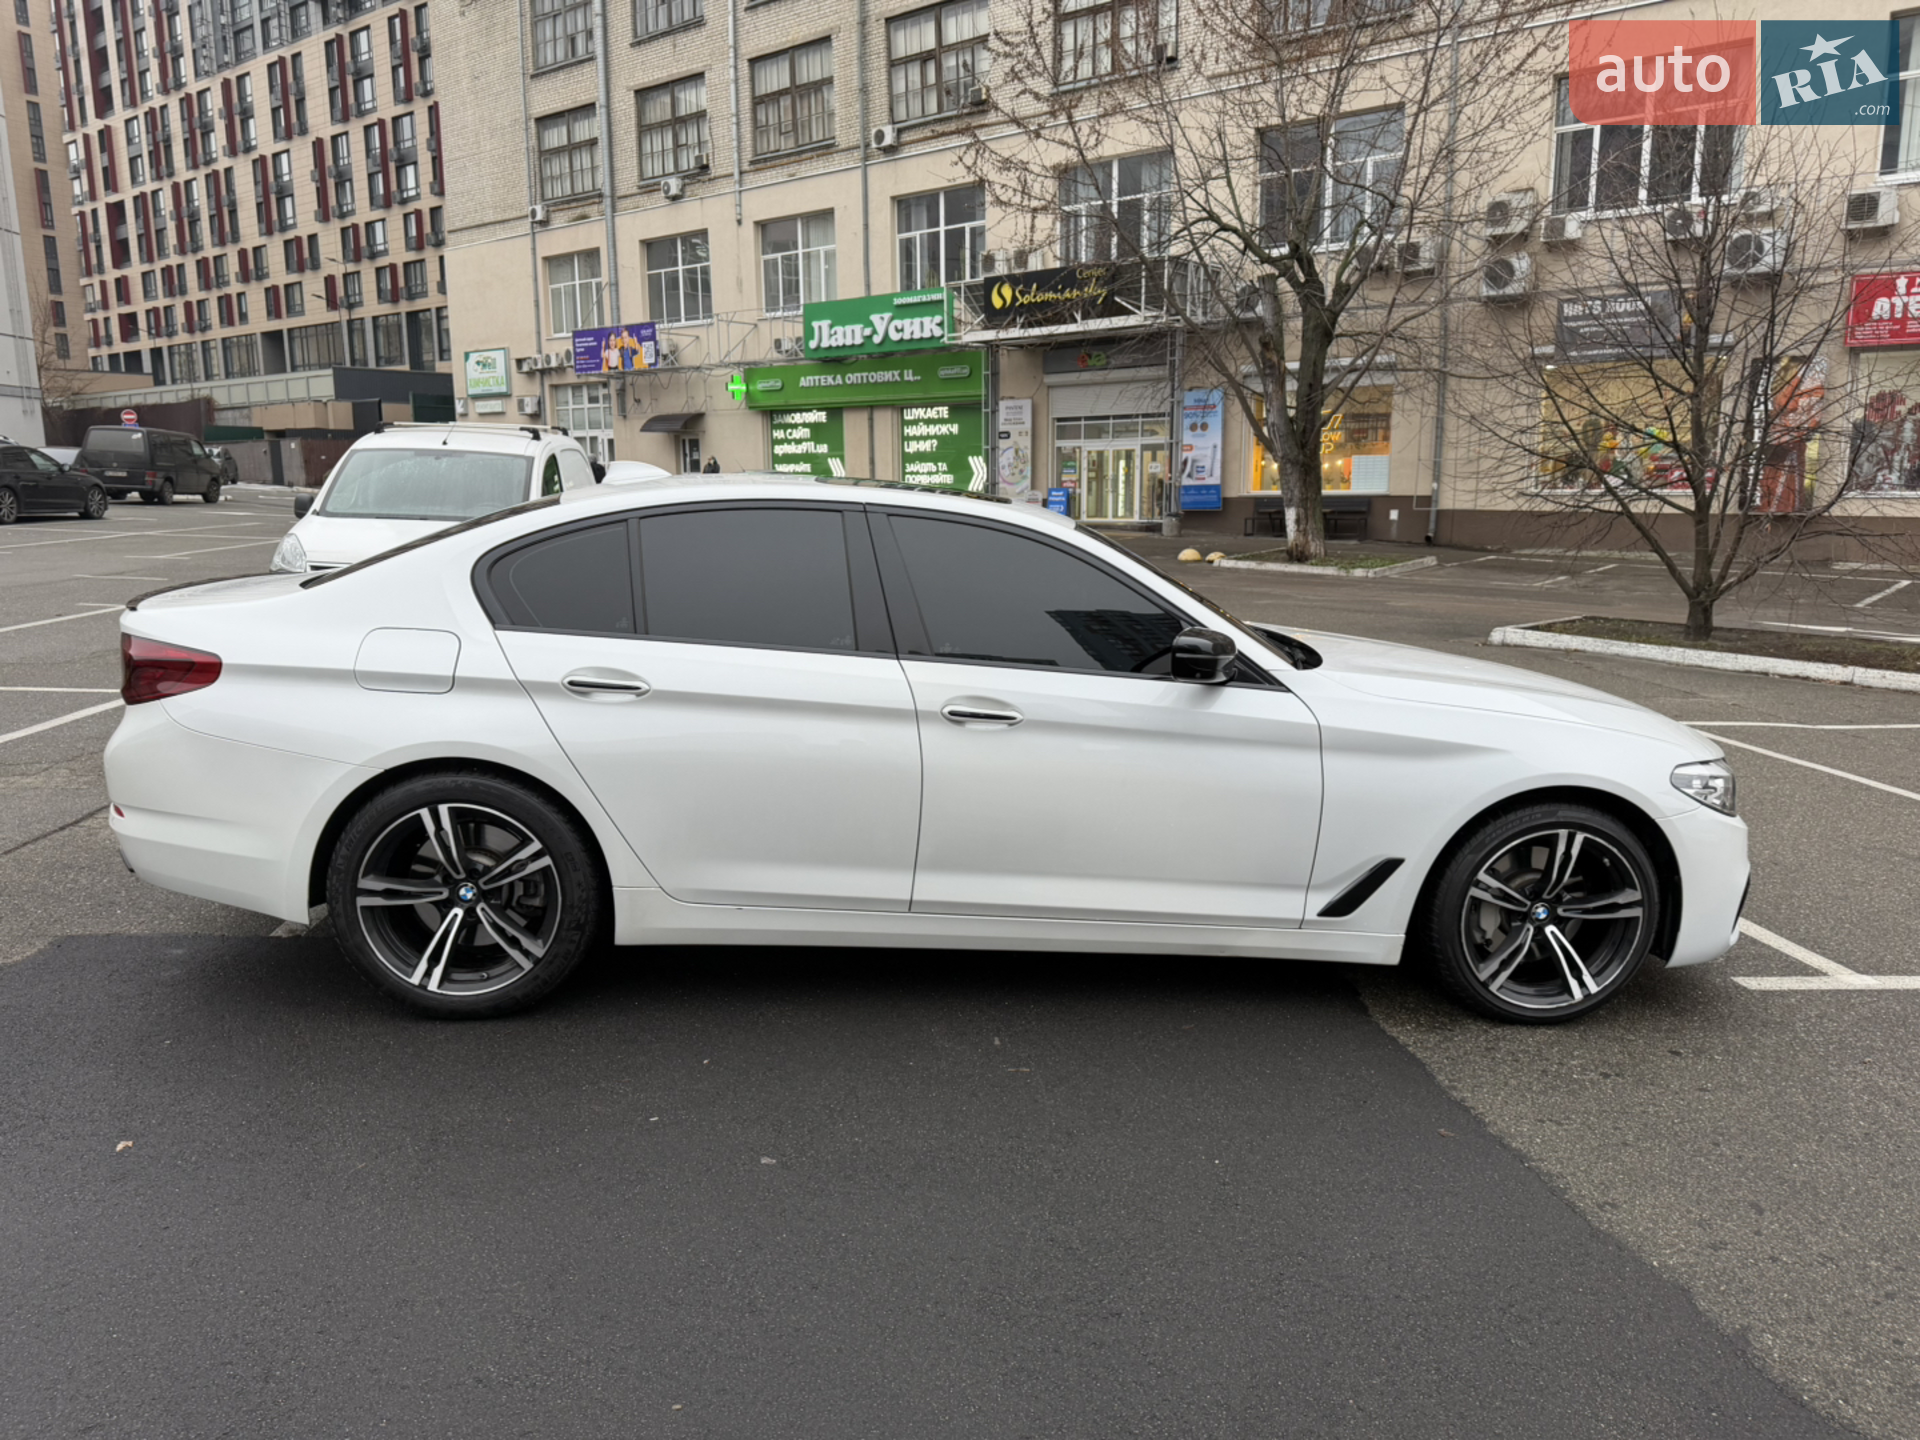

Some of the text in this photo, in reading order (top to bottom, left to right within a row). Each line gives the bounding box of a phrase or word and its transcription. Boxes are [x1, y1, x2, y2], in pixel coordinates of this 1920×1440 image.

[808, 312, 944, 350] Лап-Усик
[799, 375, 843, 389] АПТЕКА
[845, 370, 901, 386] ОПТОВИХ
[773, 410, 828, 424] ЗАМОВЛЯЙТЕ
[904, 406, 949, 420] ШУКАЄТЕ
[773, 427, 811, 440] НА САЙТІ
[904, 423, 959, 437] НАЙНИЖЧІ
[774, 443, 828, 457] apteka911.ua
[938, 461, 948, 472] ТА
